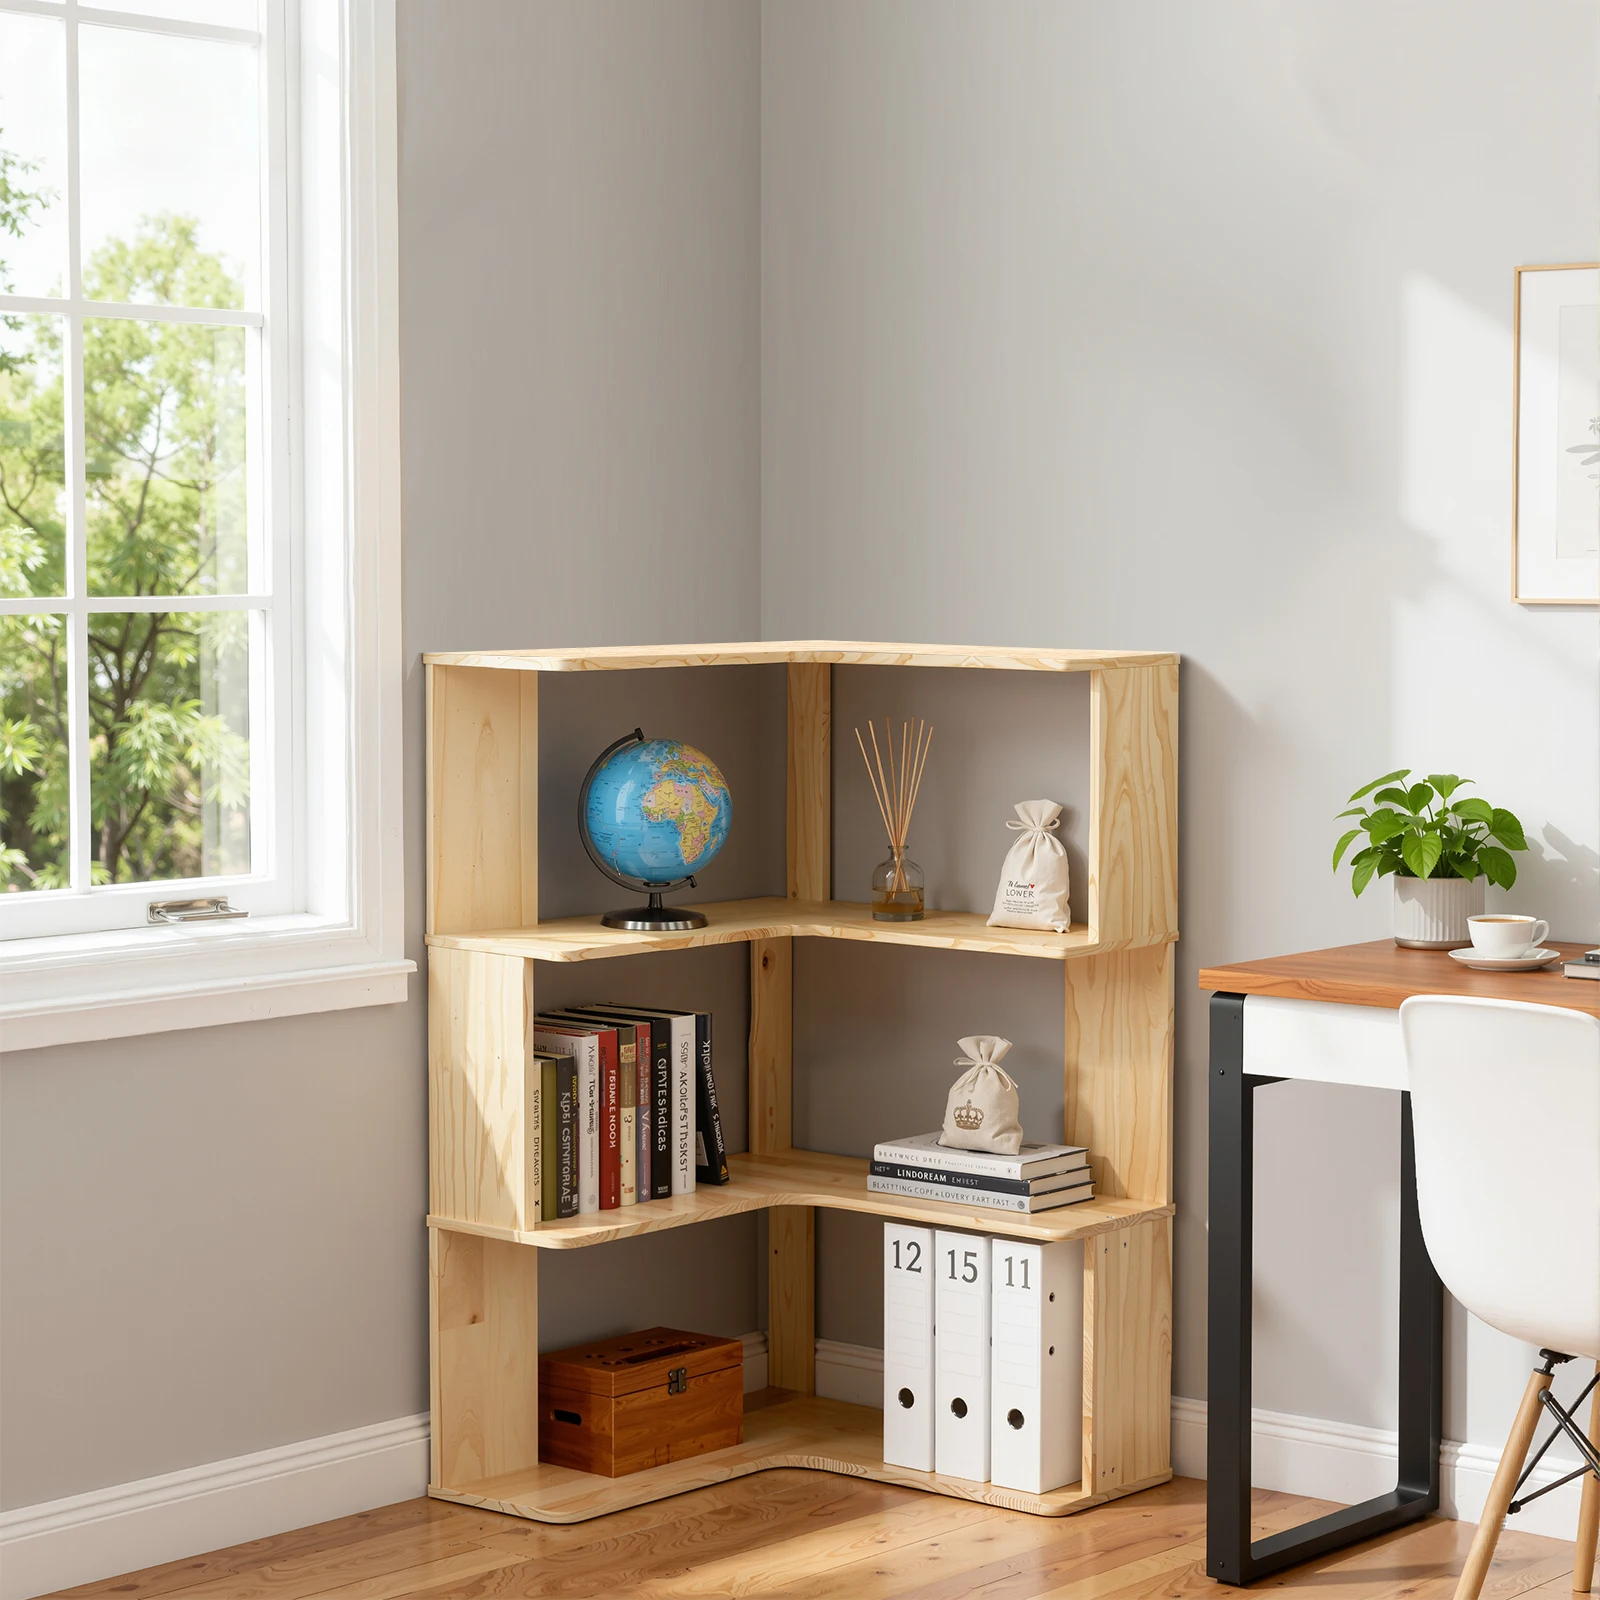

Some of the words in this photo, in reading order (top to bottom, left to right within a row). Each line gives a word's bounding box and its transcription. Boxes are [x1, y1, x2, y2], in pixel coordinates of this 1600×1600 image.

[897, 1168, 947, 1183] LINDOREAM
[892, 1239, 922, 1274] 12
[947, 1249, 978, 1284] 15
[1004, 1256, 1031, 1290] 11
